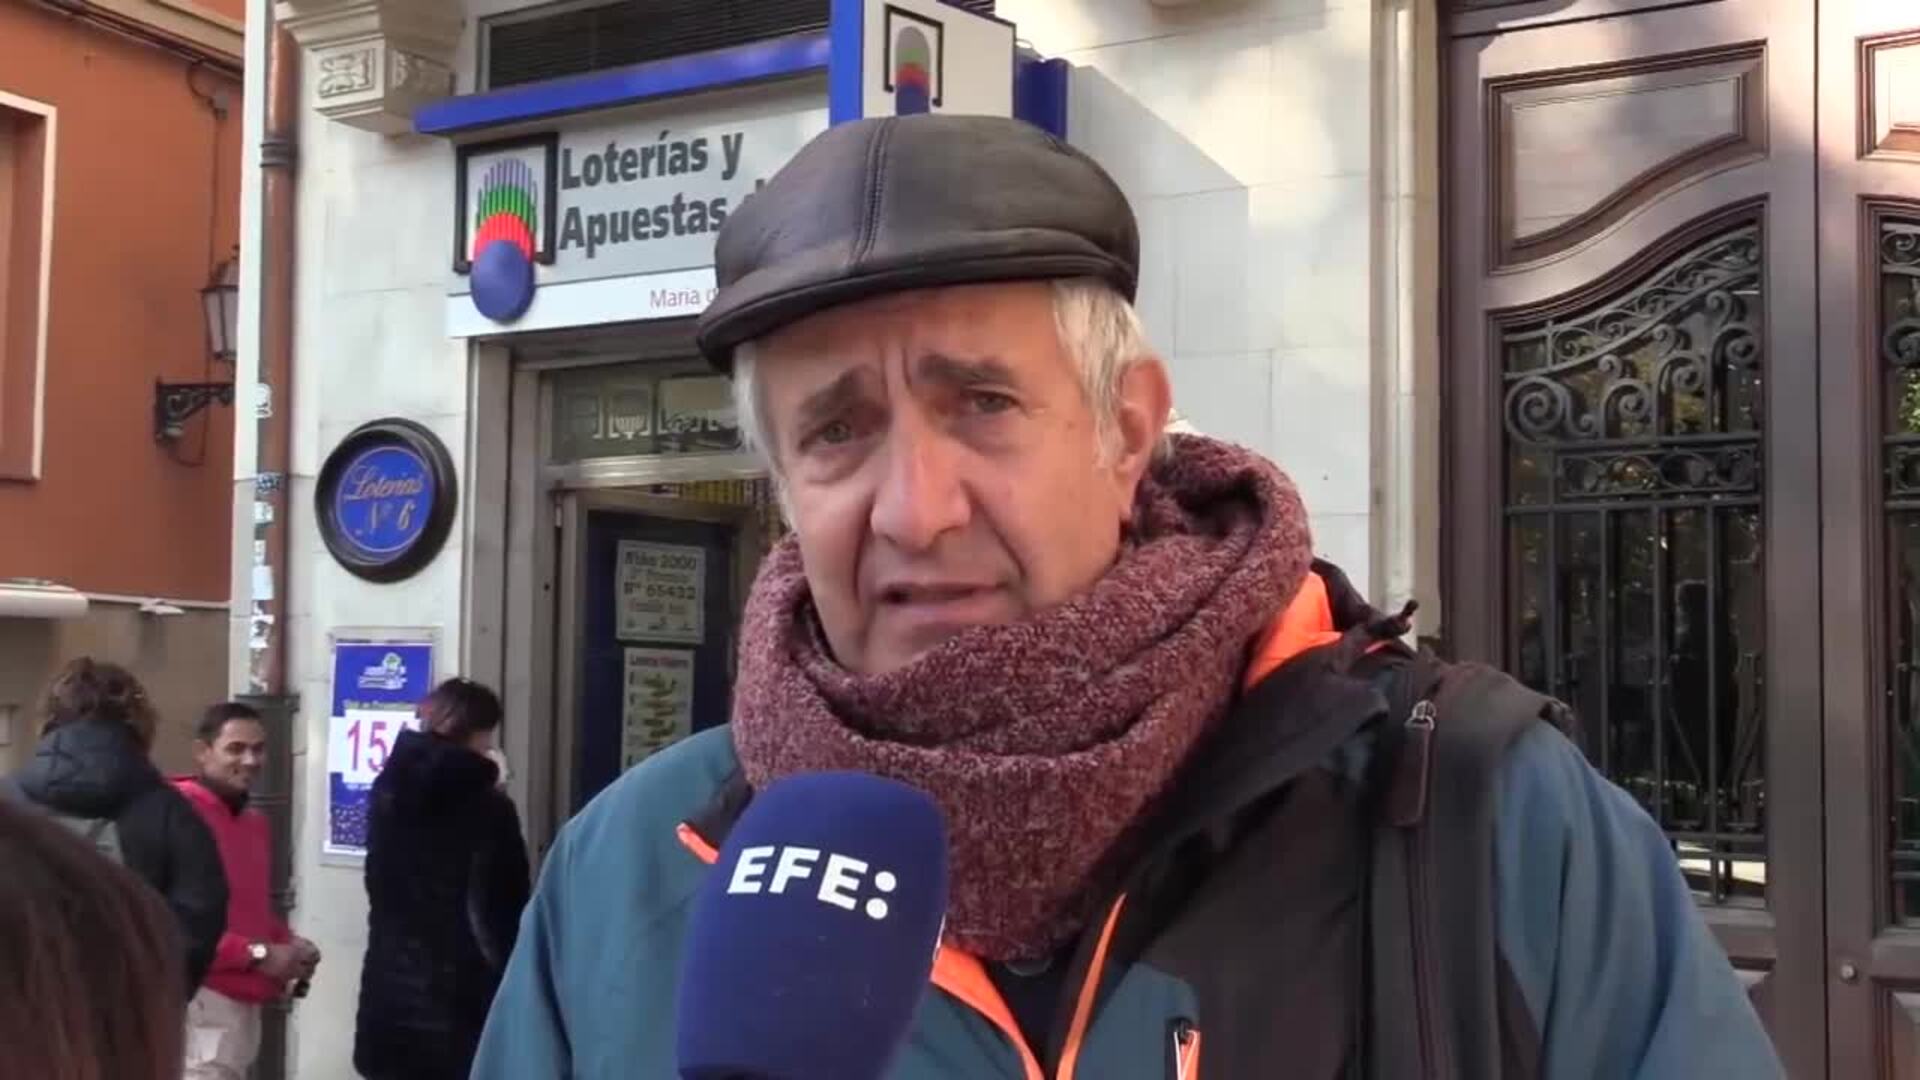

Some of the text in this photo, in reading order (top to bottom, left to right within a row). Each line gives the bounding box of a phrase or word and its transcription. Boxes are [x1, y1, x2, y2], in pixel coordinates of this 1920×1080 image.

[561, 129, 744, 190] Loterías y
[558, 192, 728, 259] Apuestas
